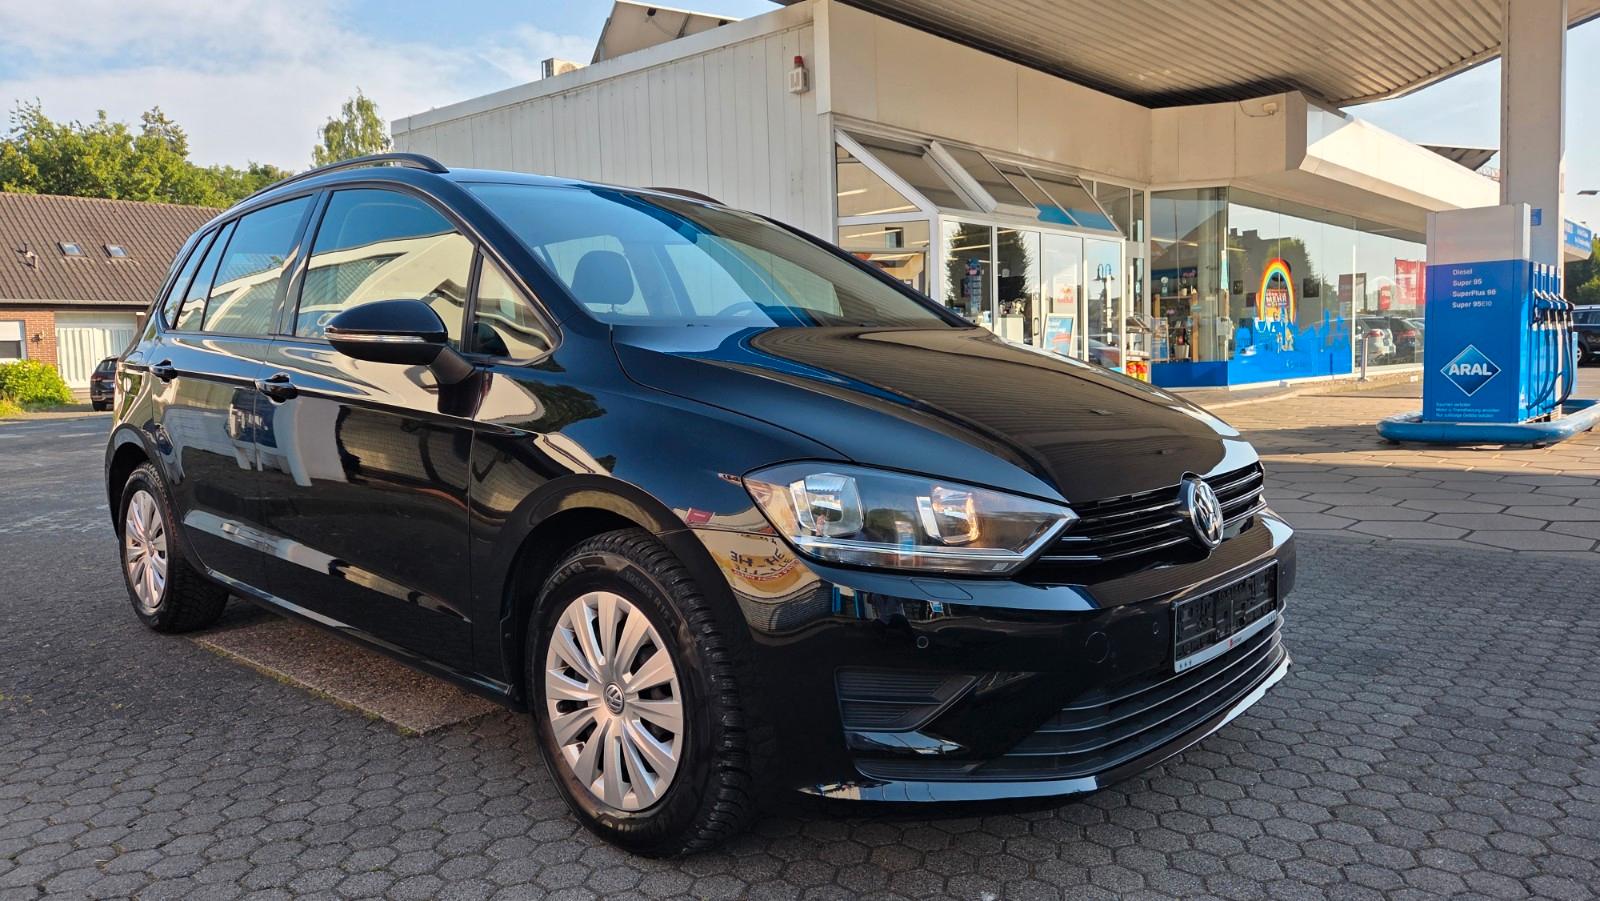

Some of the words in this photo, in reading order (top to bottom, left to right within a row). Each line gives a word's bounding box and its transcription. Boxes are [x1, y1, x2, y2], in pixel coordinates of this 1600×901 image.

[1452, 268, 1473, 276] Diesel
[1452, 290, 1486, 298] SuperPlus
[1452, 301, 1472, 309] Super
[1448, 363, 1493, 376] ARAL
